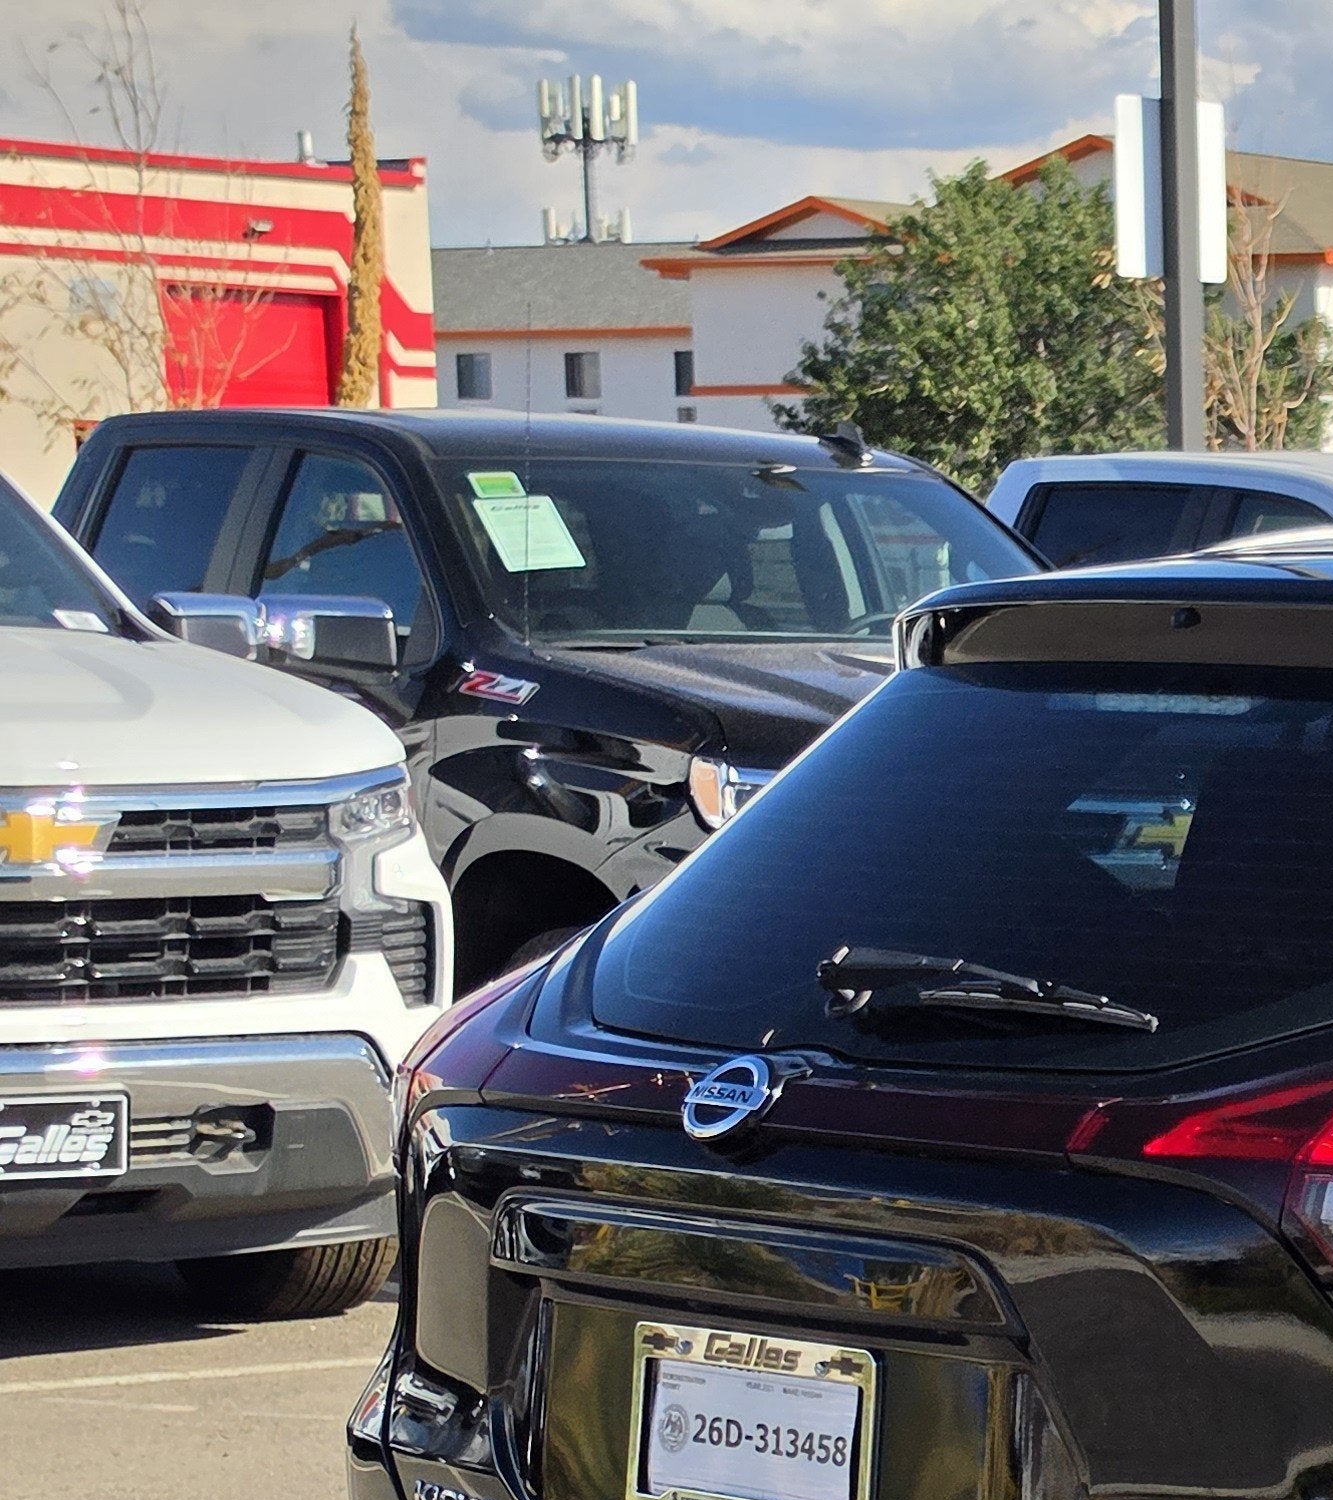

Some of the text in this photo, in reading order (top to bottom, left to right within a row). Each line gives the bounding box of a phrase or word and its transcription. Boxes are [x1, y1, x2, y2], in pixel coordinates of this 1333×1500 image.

[692, 1085, 753, 1104] NISSAN
[703, 1332, 802, 1372] Galles
[692, 1413, 847, 1467] 26D-313458
